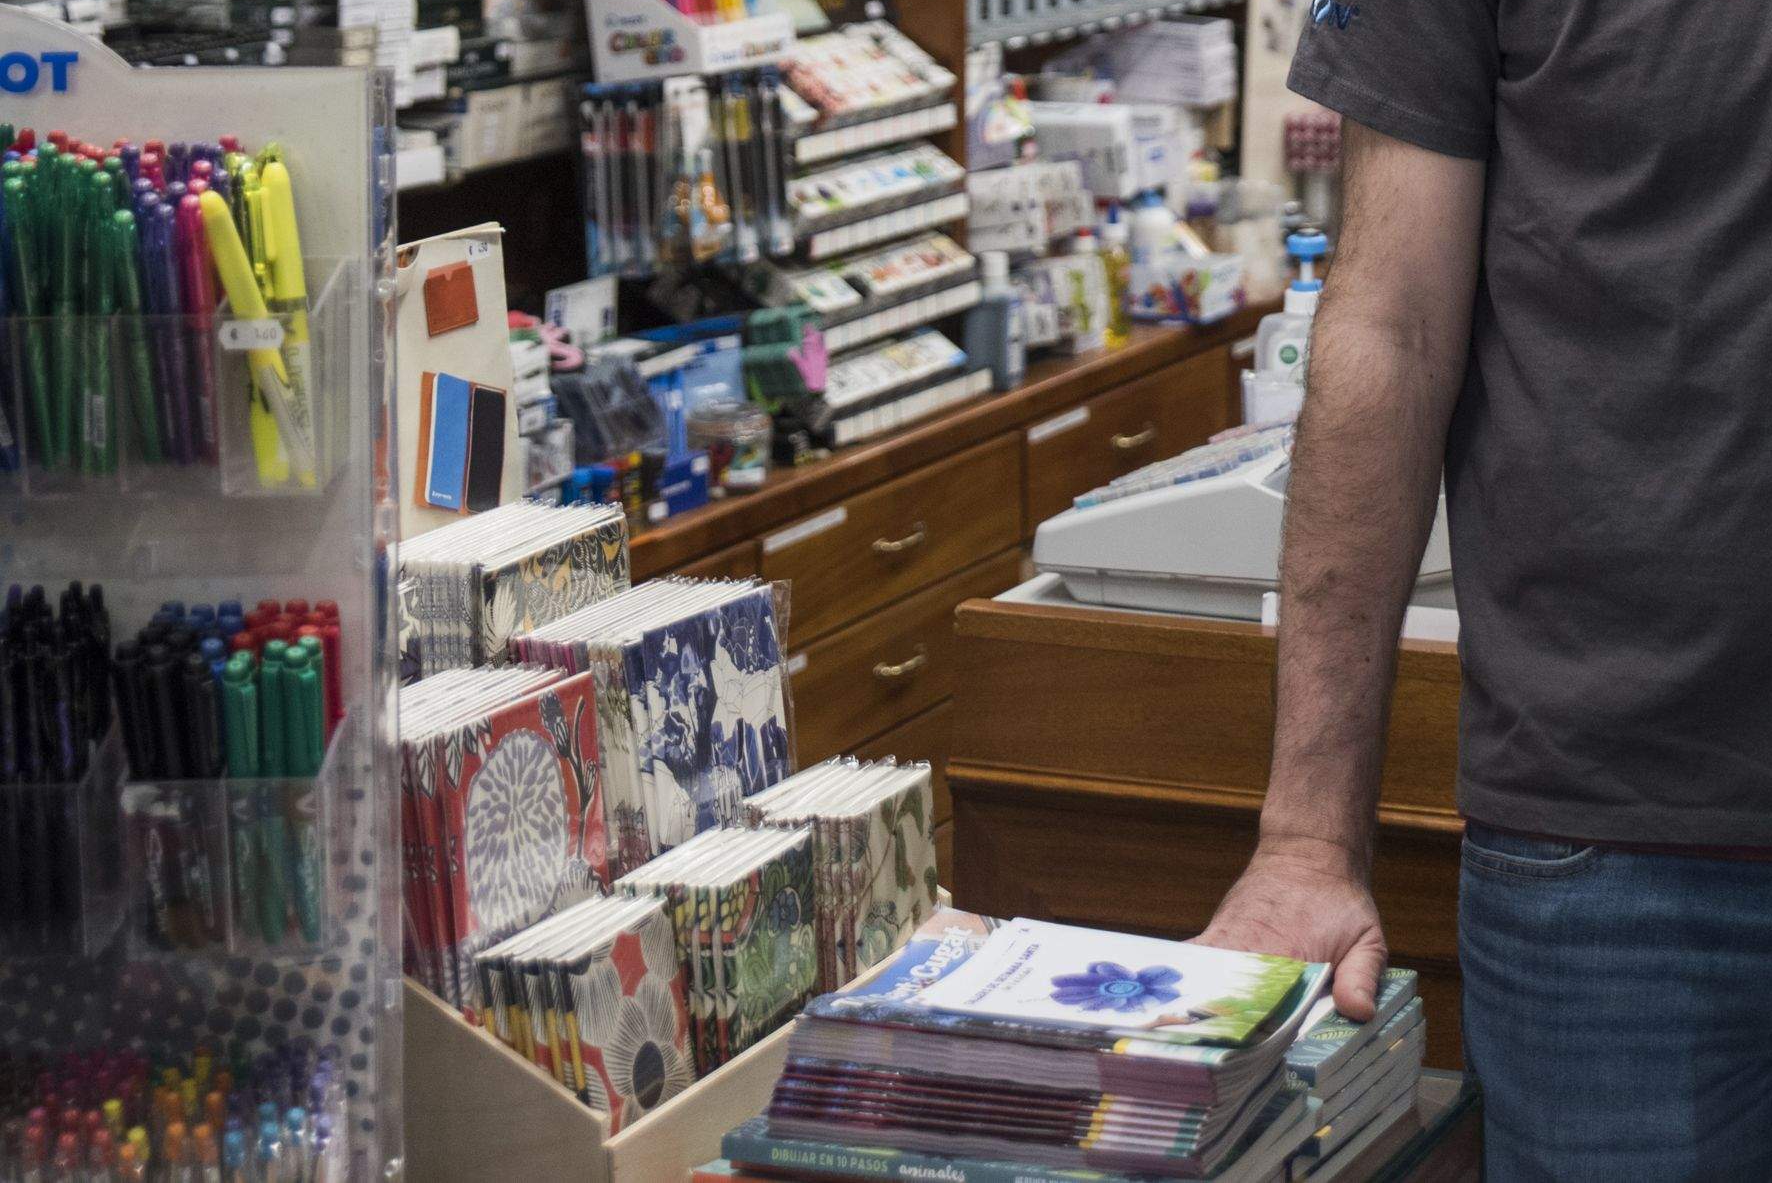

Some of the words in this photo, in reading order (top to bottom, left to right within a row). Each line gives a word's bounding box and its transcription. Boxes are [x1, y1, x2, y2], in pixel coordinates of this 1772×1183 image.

[0, 50, 79, 93] OT
[771, 1147, 816, 1166] DIBUJAR
[819, 1153, 834, 1167] EN
[837, 1155, 848, 1168] 10
[850, 1158, 889, 1173] PASOS
[898, 1163, 966, 1183] animales
